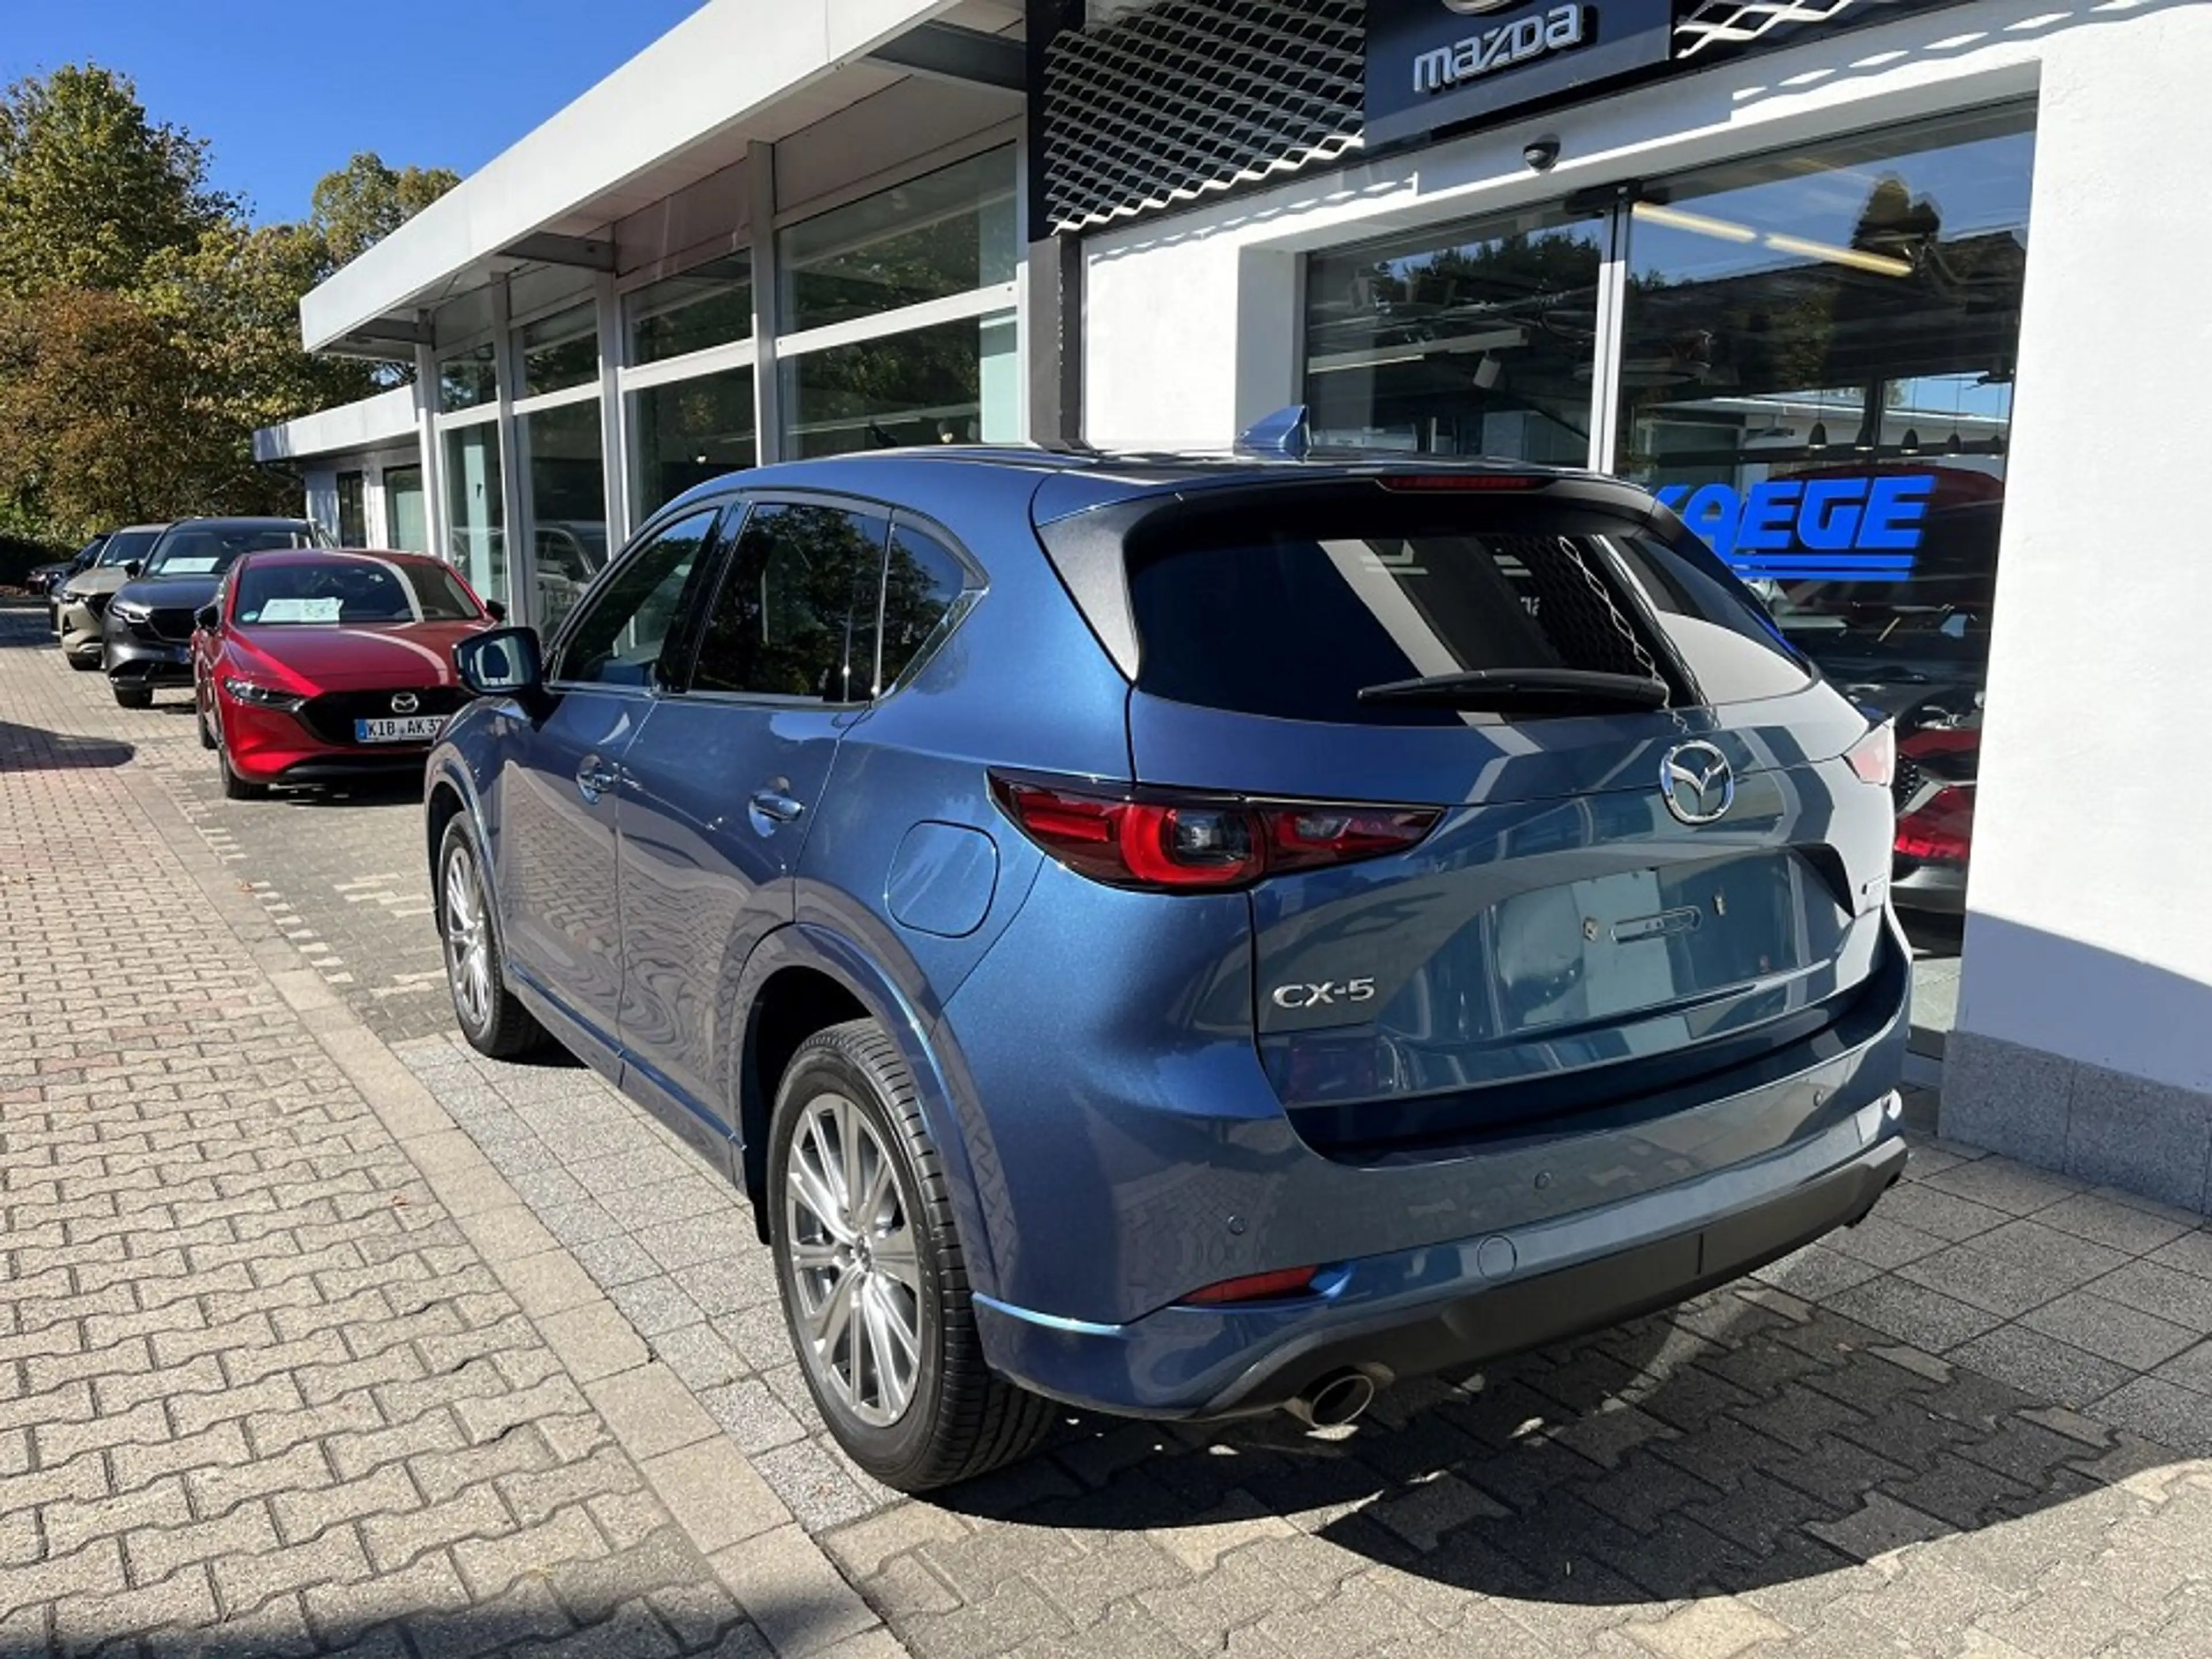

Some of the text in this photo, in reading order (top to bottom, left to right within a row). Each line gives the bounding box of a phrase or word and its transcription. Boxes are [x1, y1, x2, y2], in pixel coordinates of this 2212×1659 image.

[1414, 4, 1582, 93] mazda
[368, 721, 395, 736] KIB
[1272, 978, 1375, 1008] CX-5
